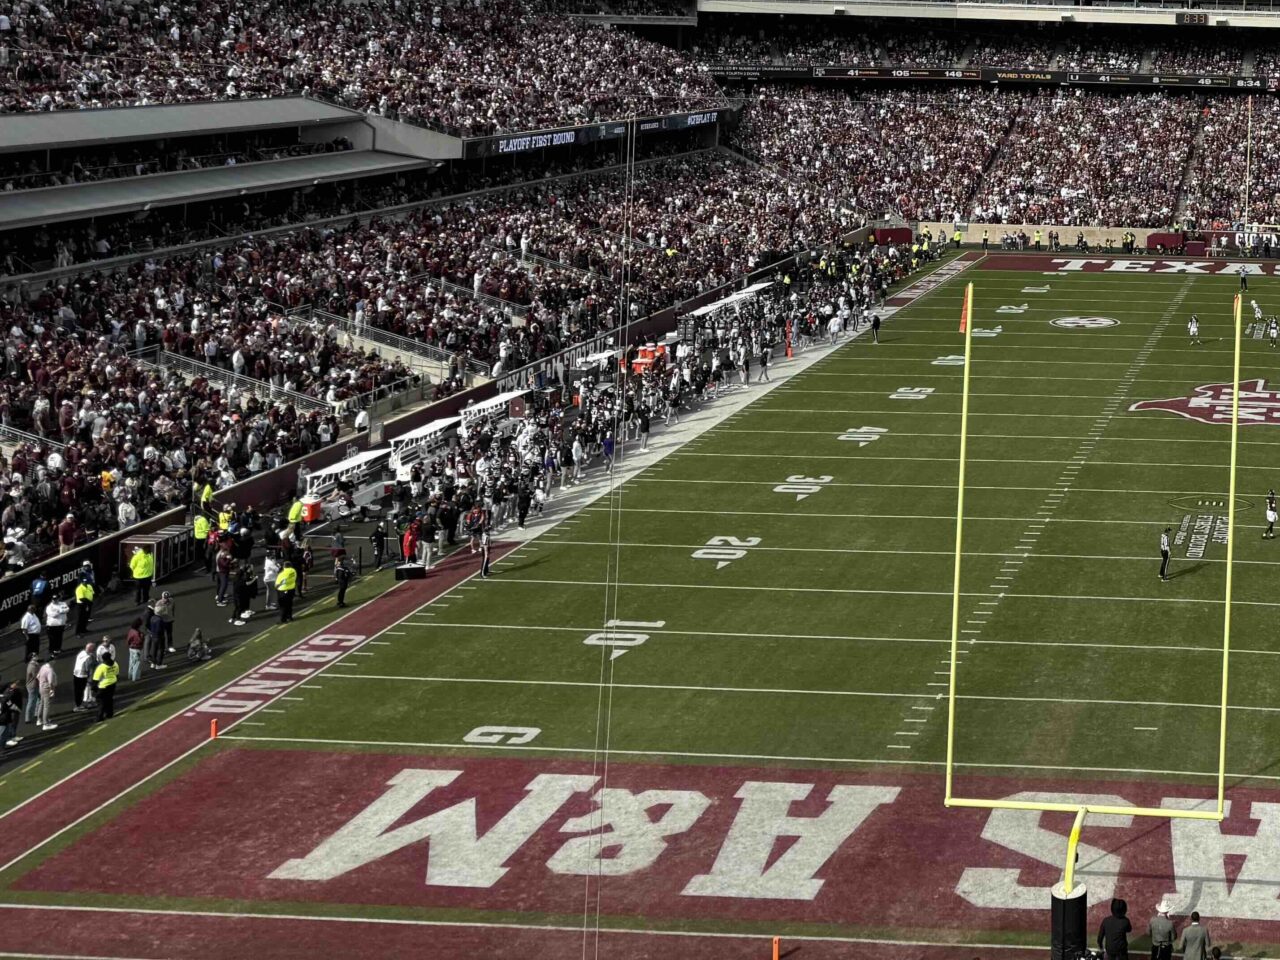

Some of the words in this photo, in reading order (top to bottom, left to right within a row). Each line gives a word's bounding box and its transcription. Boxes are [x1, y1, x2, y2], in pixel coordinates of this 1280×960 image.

[498, 135, 531, 153] PLAYOFF
[531, 134, 551, 149] FIRST
[553, 131, 575, 146] ROUND
[889, 387, 936, 400] 50
[837, 426, 889, 441] 40
[772, 474, 834, 493] 30
[690, 535, 763, 560] 20
[1186, 534, 1209, 558] ROUND
[583, 619, 666, 646] 10
[463, 725, 542, 745] G
[266, 768, 902, 901] A&M
